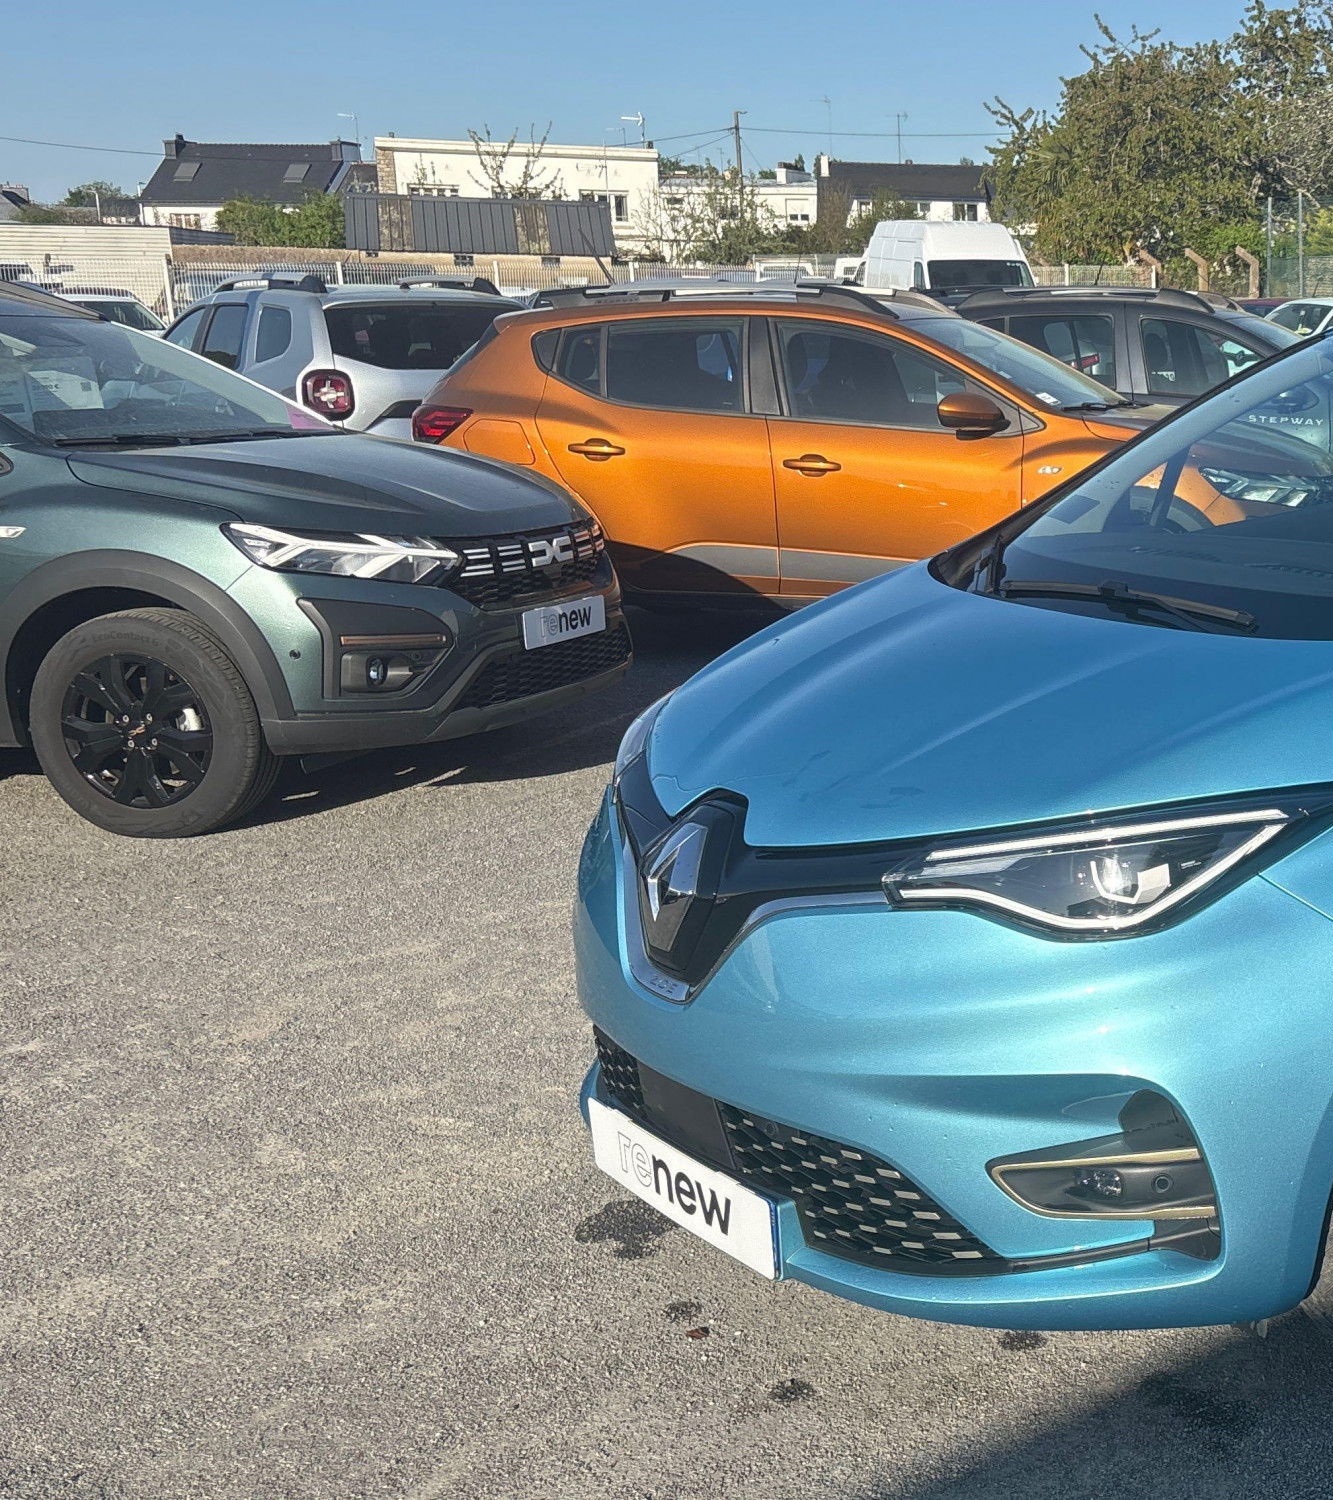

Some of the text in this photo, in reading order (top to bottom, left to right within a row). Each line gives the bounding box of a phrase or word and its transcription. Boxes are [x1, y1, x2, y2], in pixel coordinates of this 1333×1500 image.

[1248, 414, 1325, 427] STEPWAY
[539, 606, 592, 638] renew
[616, 1130, 732, 1236] renew
